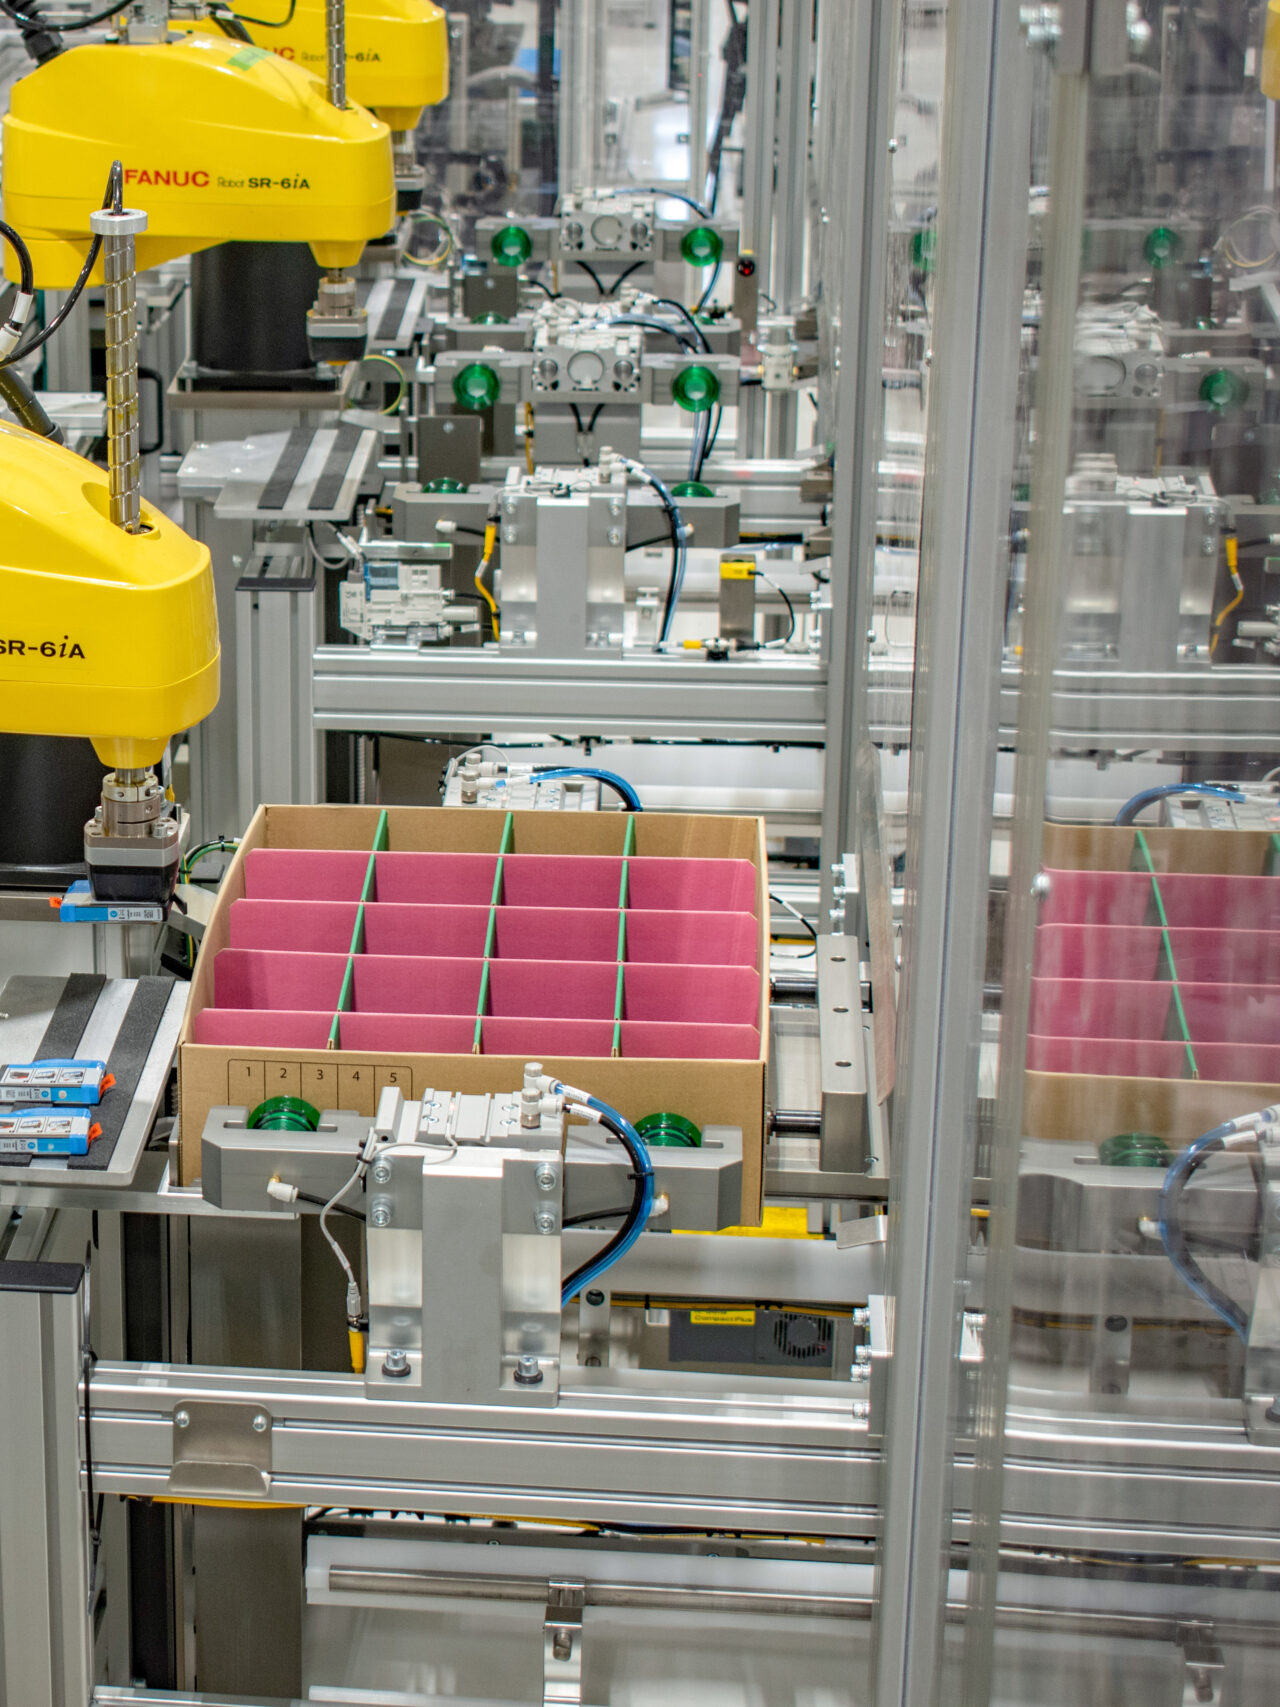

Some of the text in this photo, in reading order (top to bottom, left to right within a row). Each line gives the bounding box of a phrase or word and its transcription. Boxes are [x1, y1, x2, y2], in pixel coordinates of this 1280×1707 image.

[124, 169, 310, 189] FANUC Robot SR-6iA
[246, 1066, 397, 1083] 1 2 3 4 5
